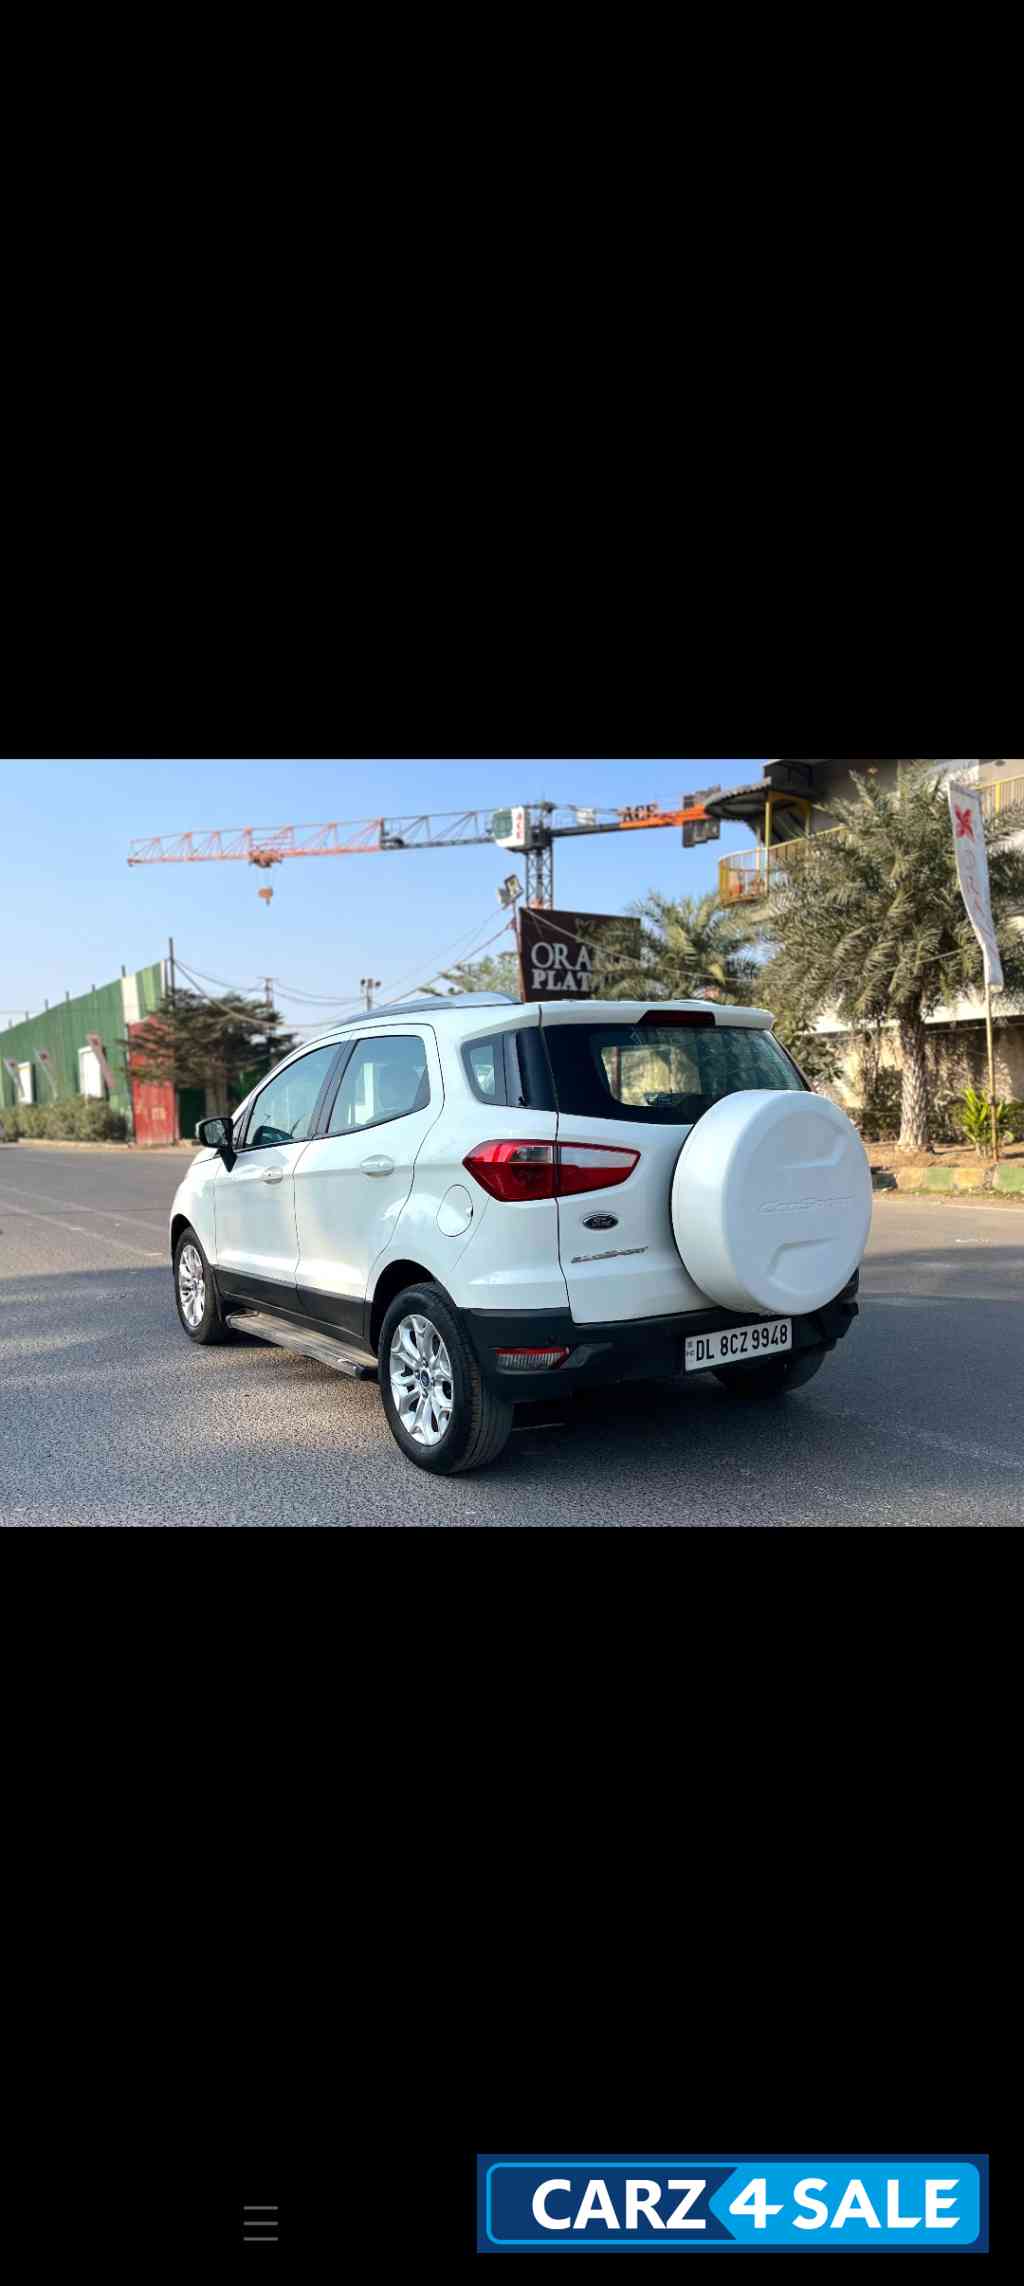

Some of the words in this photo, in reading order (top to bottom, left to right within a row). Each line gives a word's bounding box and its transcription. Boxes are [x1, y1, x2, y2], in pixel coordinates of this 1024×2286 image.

[531, 942, 593, 970] ORA
[531, 969, 595, 991] PLAT
[695, 1337, 715, 1361] DL
[720, 1331, 748, 1356] 8CZ
[752, 1324, 788, 1350] 9948
